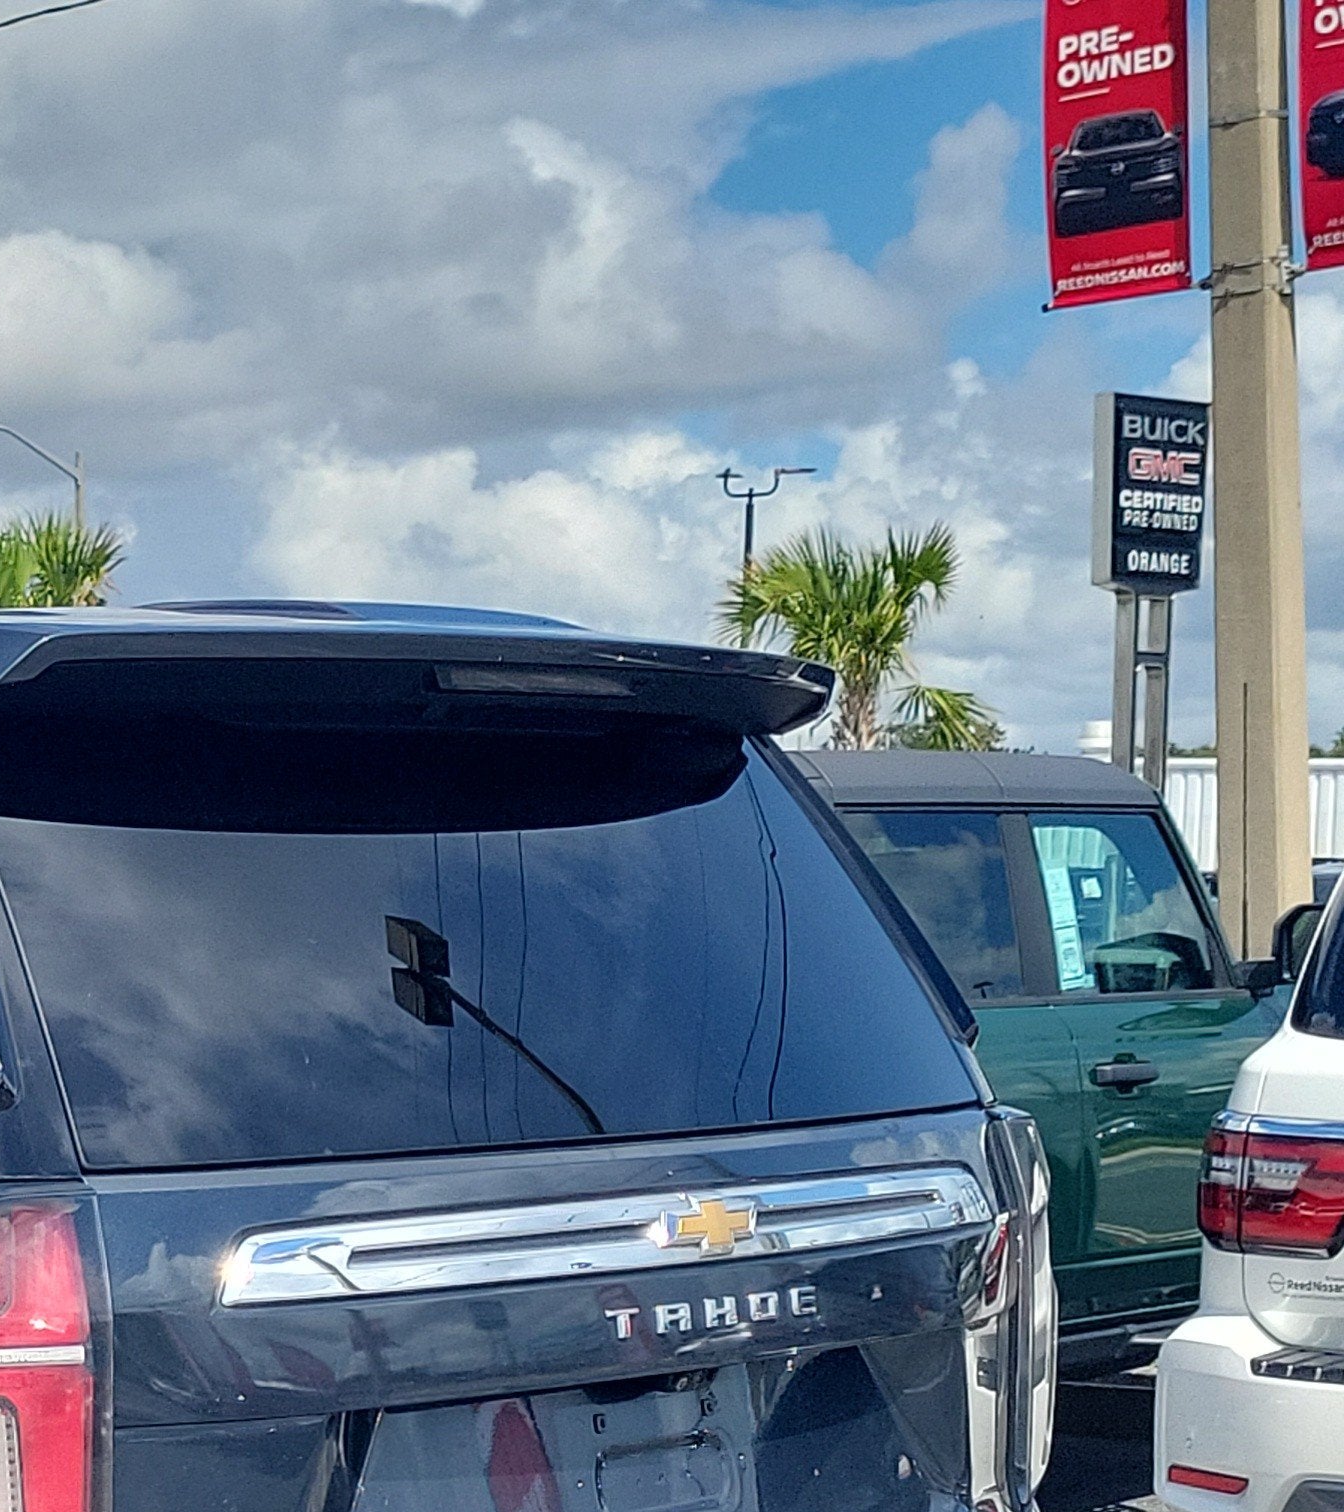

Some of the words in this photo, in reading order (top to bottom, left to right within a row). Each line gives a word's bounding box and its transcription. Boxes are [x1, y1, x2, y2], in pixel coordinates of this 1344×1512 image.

[1058, 25, 1134, 62] PRE-
[1057, 43, 1174, 88] OWNED
[1122, 415, 1204, 446] BUICK
[1128, 447, 1201, 485] GMC
[1118, 489, 1203, 513] CERTIFIED
[1123, 510, 1199, 532] PRE-OWNED
[1127, 550, 1191, 575] ORANGE
[604, 1285, 818, 1340] TAHOE
